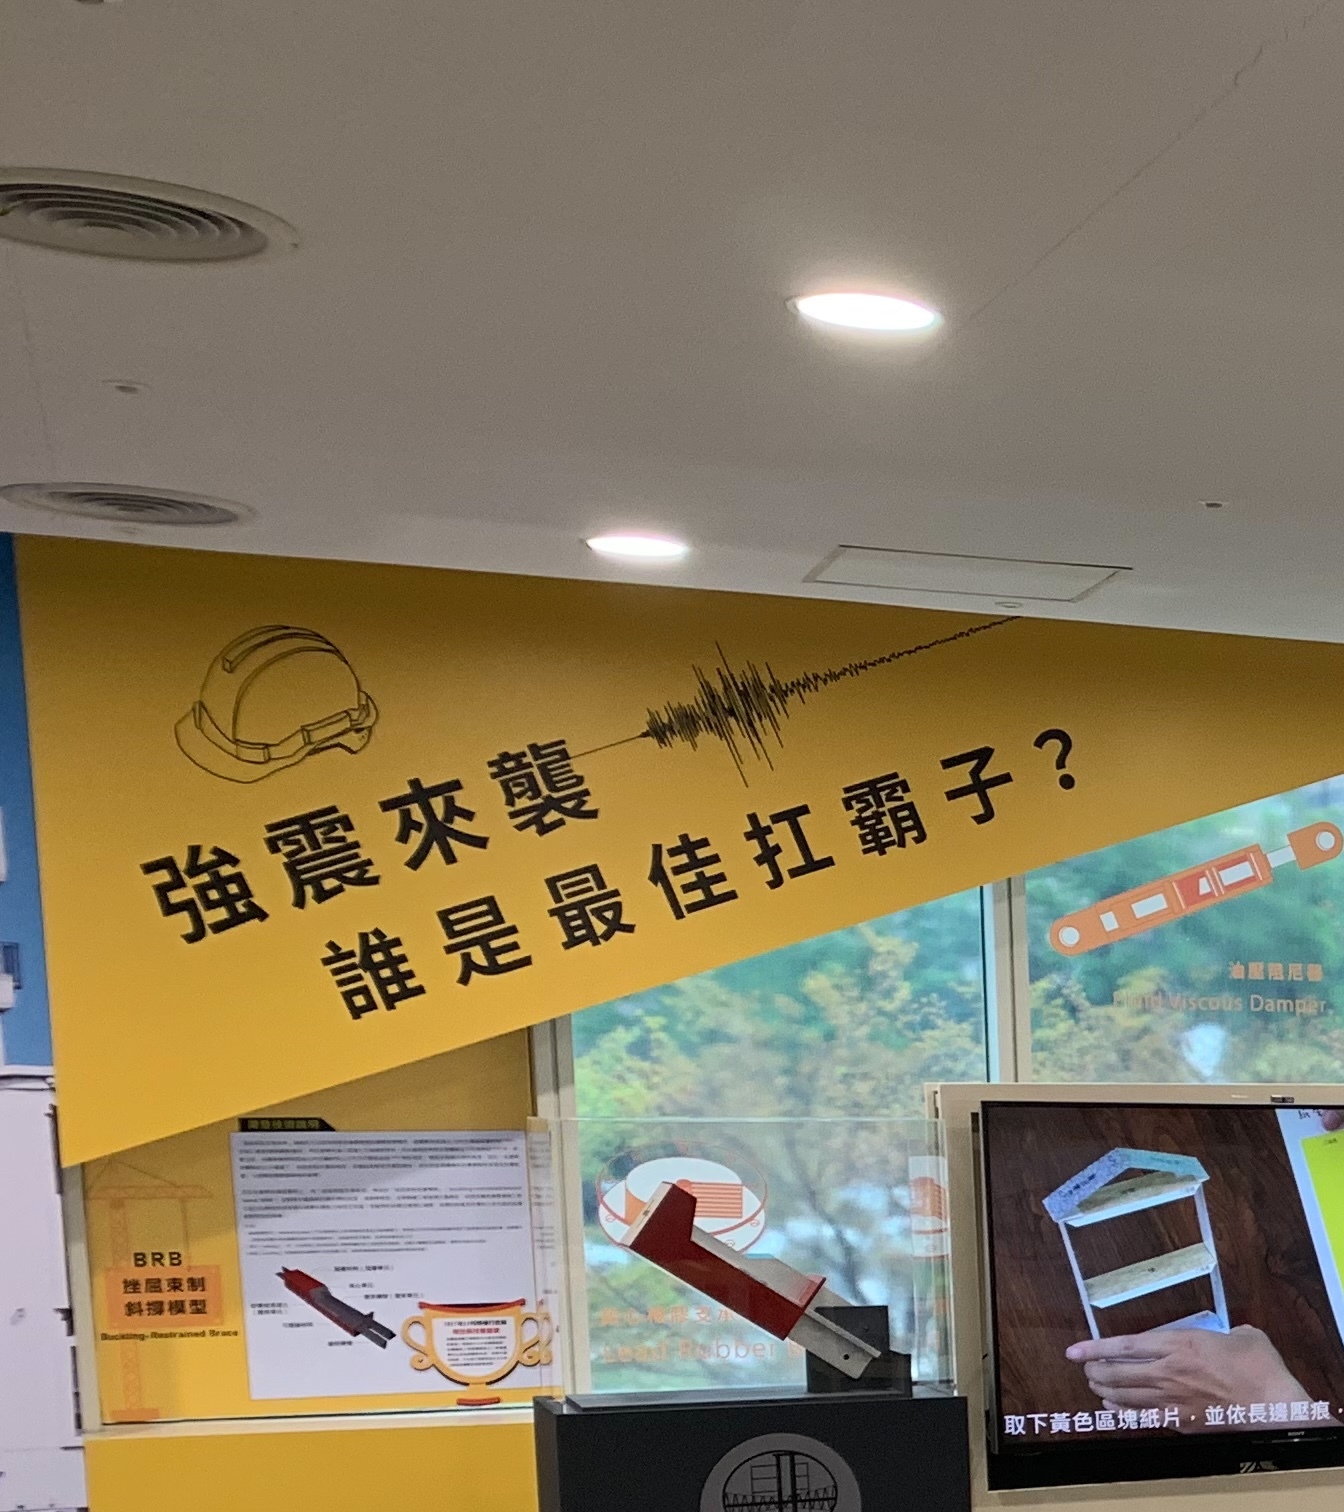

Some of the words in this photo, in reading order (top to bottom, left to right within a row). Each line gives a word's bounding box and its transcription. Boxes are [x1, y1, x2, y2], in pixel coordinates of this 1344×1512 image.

[139, 738, 601, 945] 強震來襲
[133, 1251, 182, 1267] BRB
[122, 1276, 206, 1294] 挫屈束制
